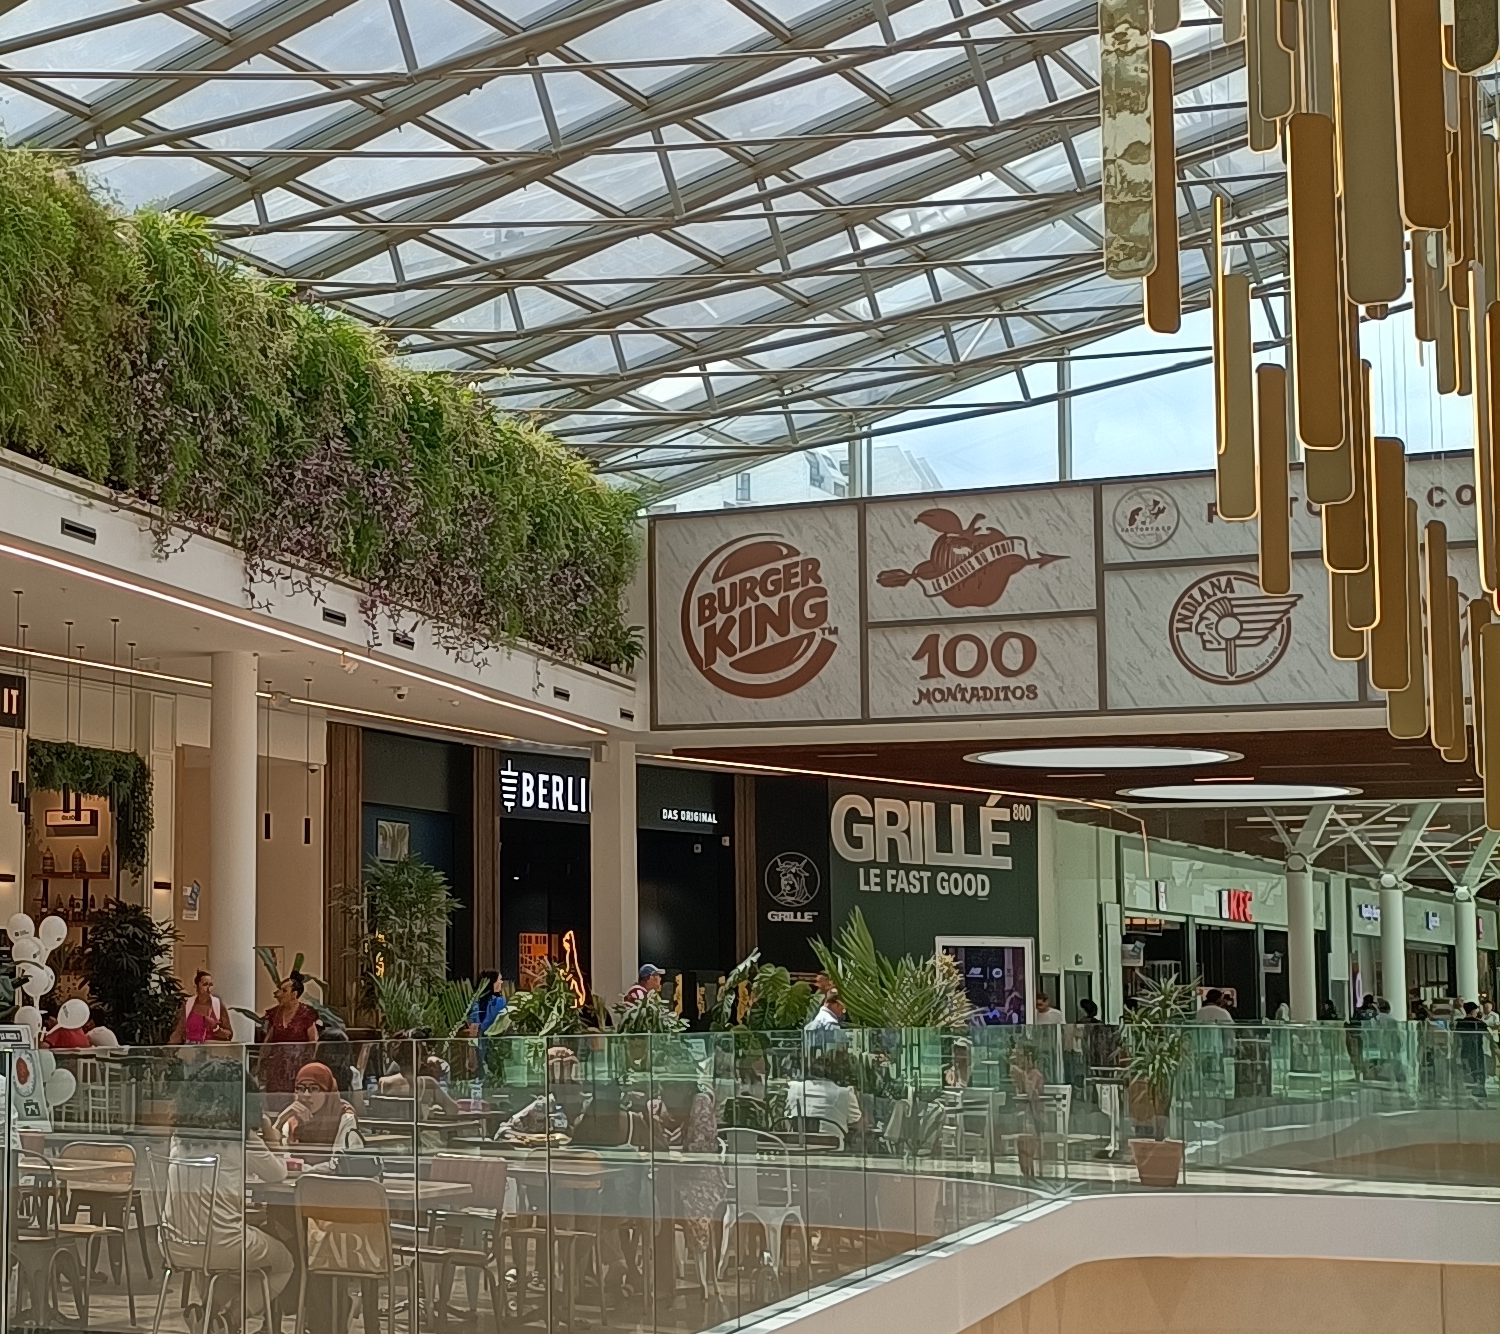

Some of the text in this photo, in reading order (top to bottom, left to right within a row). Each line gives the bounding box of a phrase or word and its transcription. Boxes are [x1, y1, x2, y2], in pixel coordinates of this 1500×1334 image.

[932, 539, 1016, 593] LE PARADIS DU FRUIT
[697, 557, 823, 628] BURGER
[1175, 576, 1236, 634] INDIANA
[703, 585, 829, 669] KING
[911, 631, 1038, 681] 100
[3, 687, 19, 715] IT
[912, 683, 1039, 706] MONTADITOS
[521, 771, 592, 814] BERLI
[662, 808, 718, 824] DAS ORIGINAL
[830, 794, 1013, 870] GRILLÉ
[858, 868, 991, 900] LE FAST GOOD
